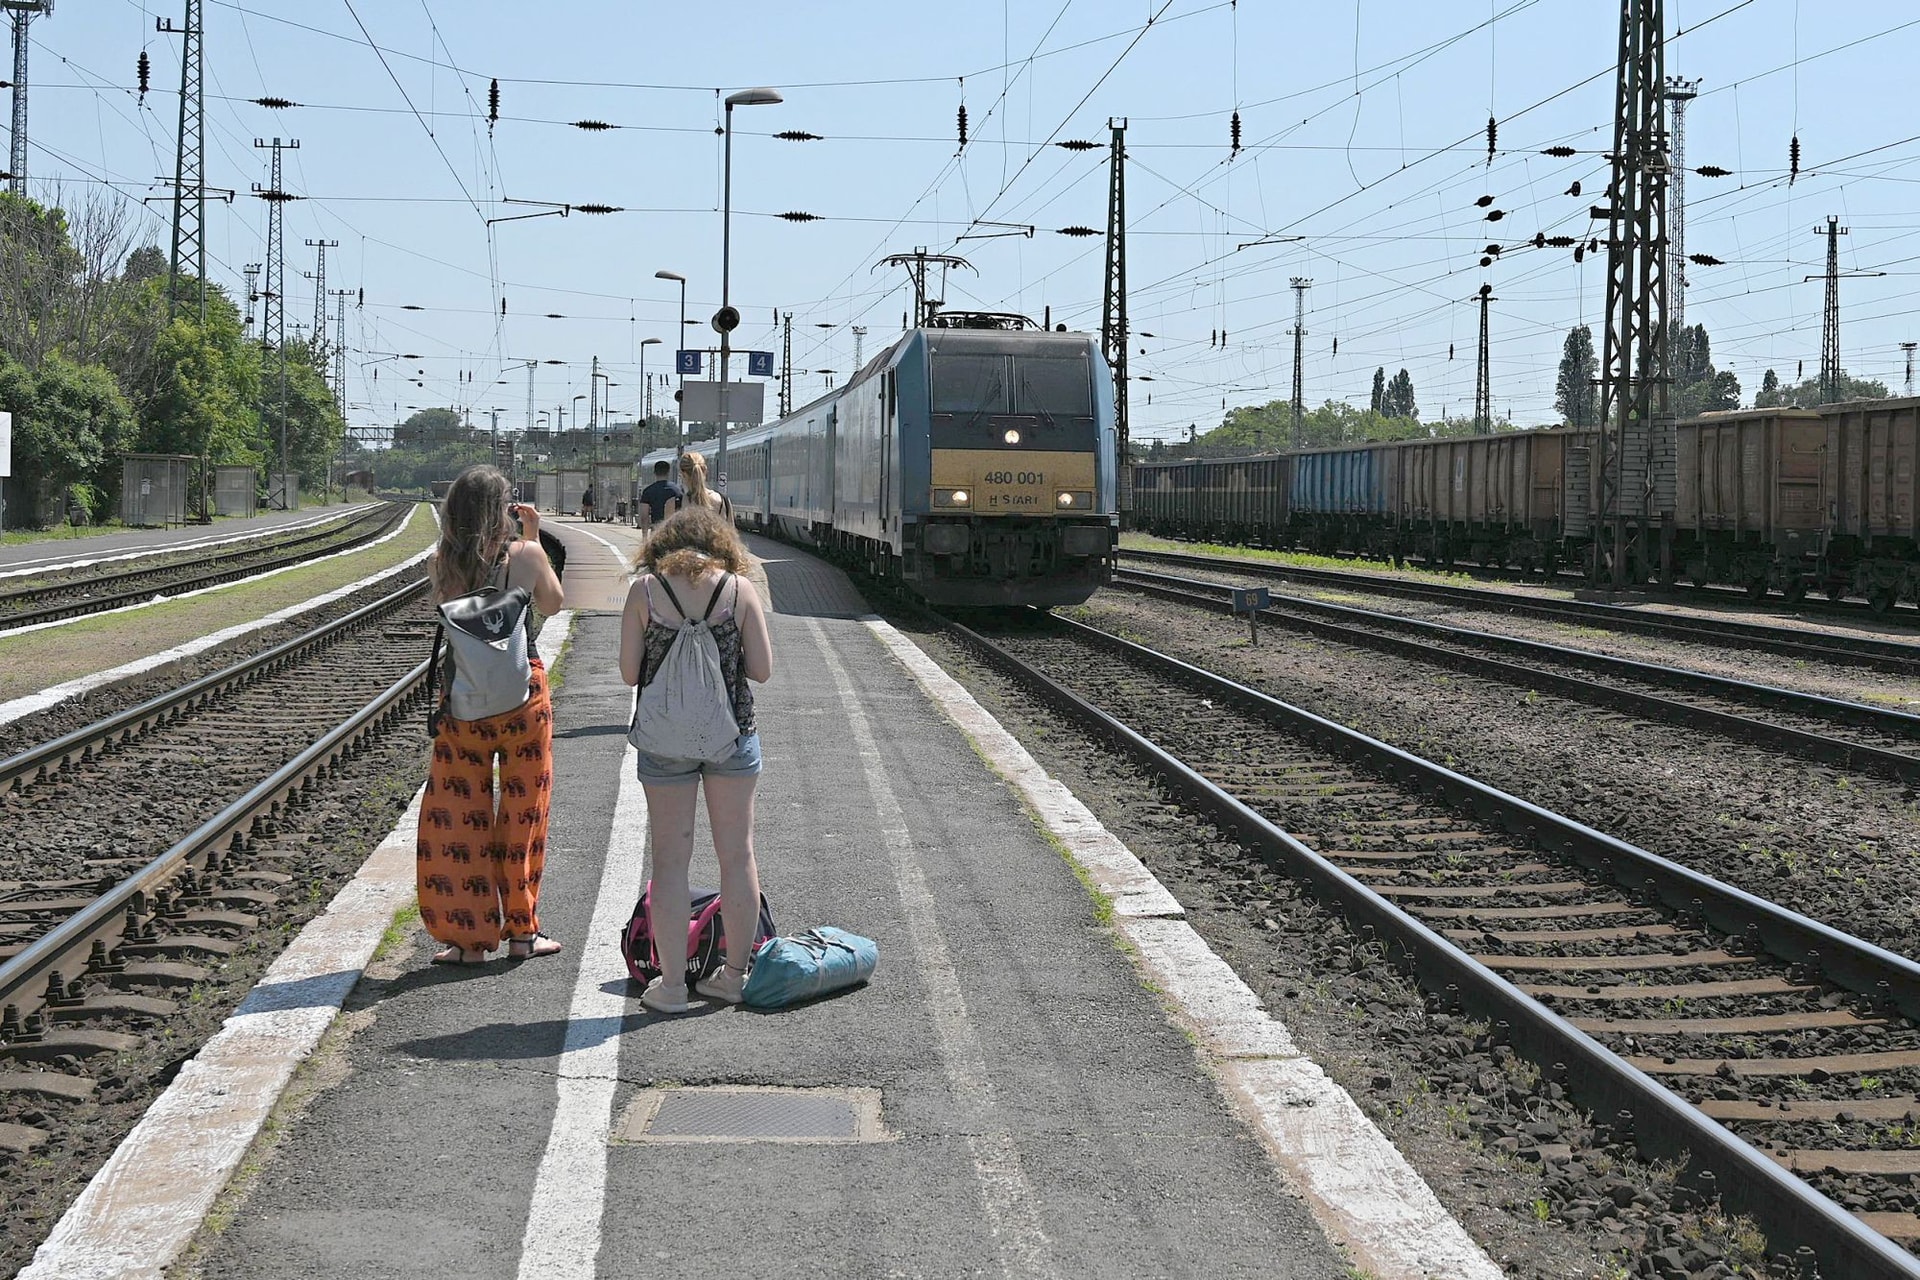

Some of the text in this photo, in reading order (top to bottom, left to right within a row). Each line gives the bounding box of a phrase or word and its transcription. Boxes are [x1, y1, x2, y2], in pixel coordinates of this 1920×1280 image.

[685, 354, 693, 367] 3
[757, 356, 766, 368] 4
[984, 471, 1044, 485] 480 001
[989, 495, 998, 505] H
[1245, 593, 1258, 606] 69
